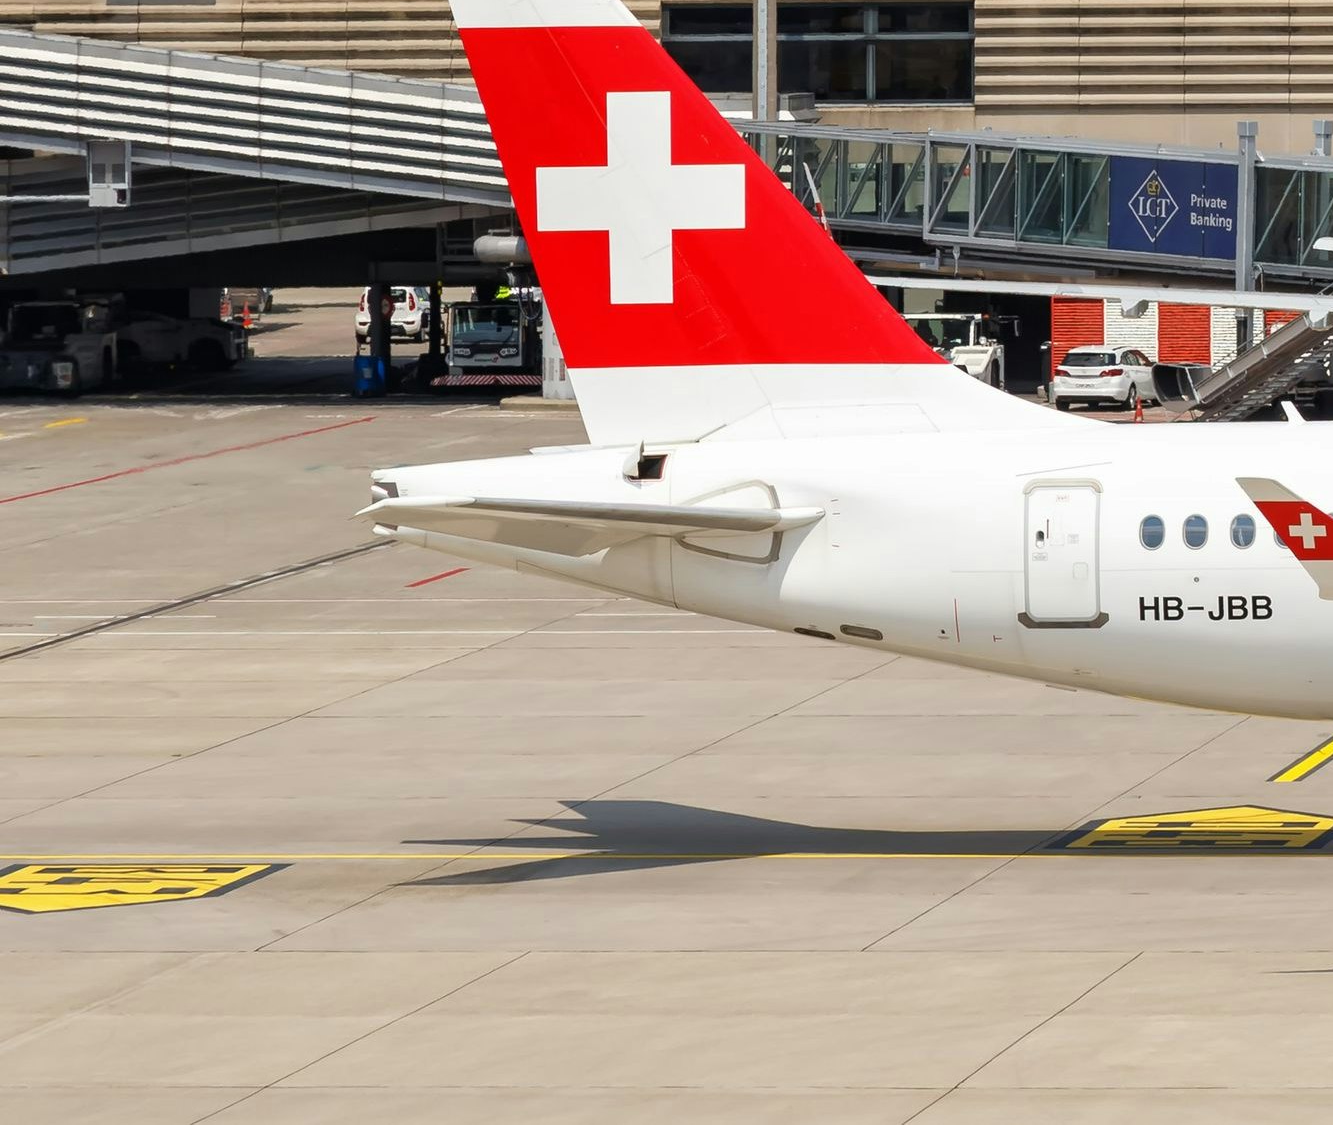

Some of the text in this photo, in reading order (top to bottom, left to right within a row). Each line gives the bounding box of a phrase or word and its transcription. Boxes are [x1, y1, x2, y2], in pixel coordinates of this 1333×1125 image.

[1137, 196, 1170, 217] LGT
[1190, 193, 1227, 209] Private
[1190, 212, 1232, 231] Banking
[1139, 596, 1273, 621] HB-JBB
